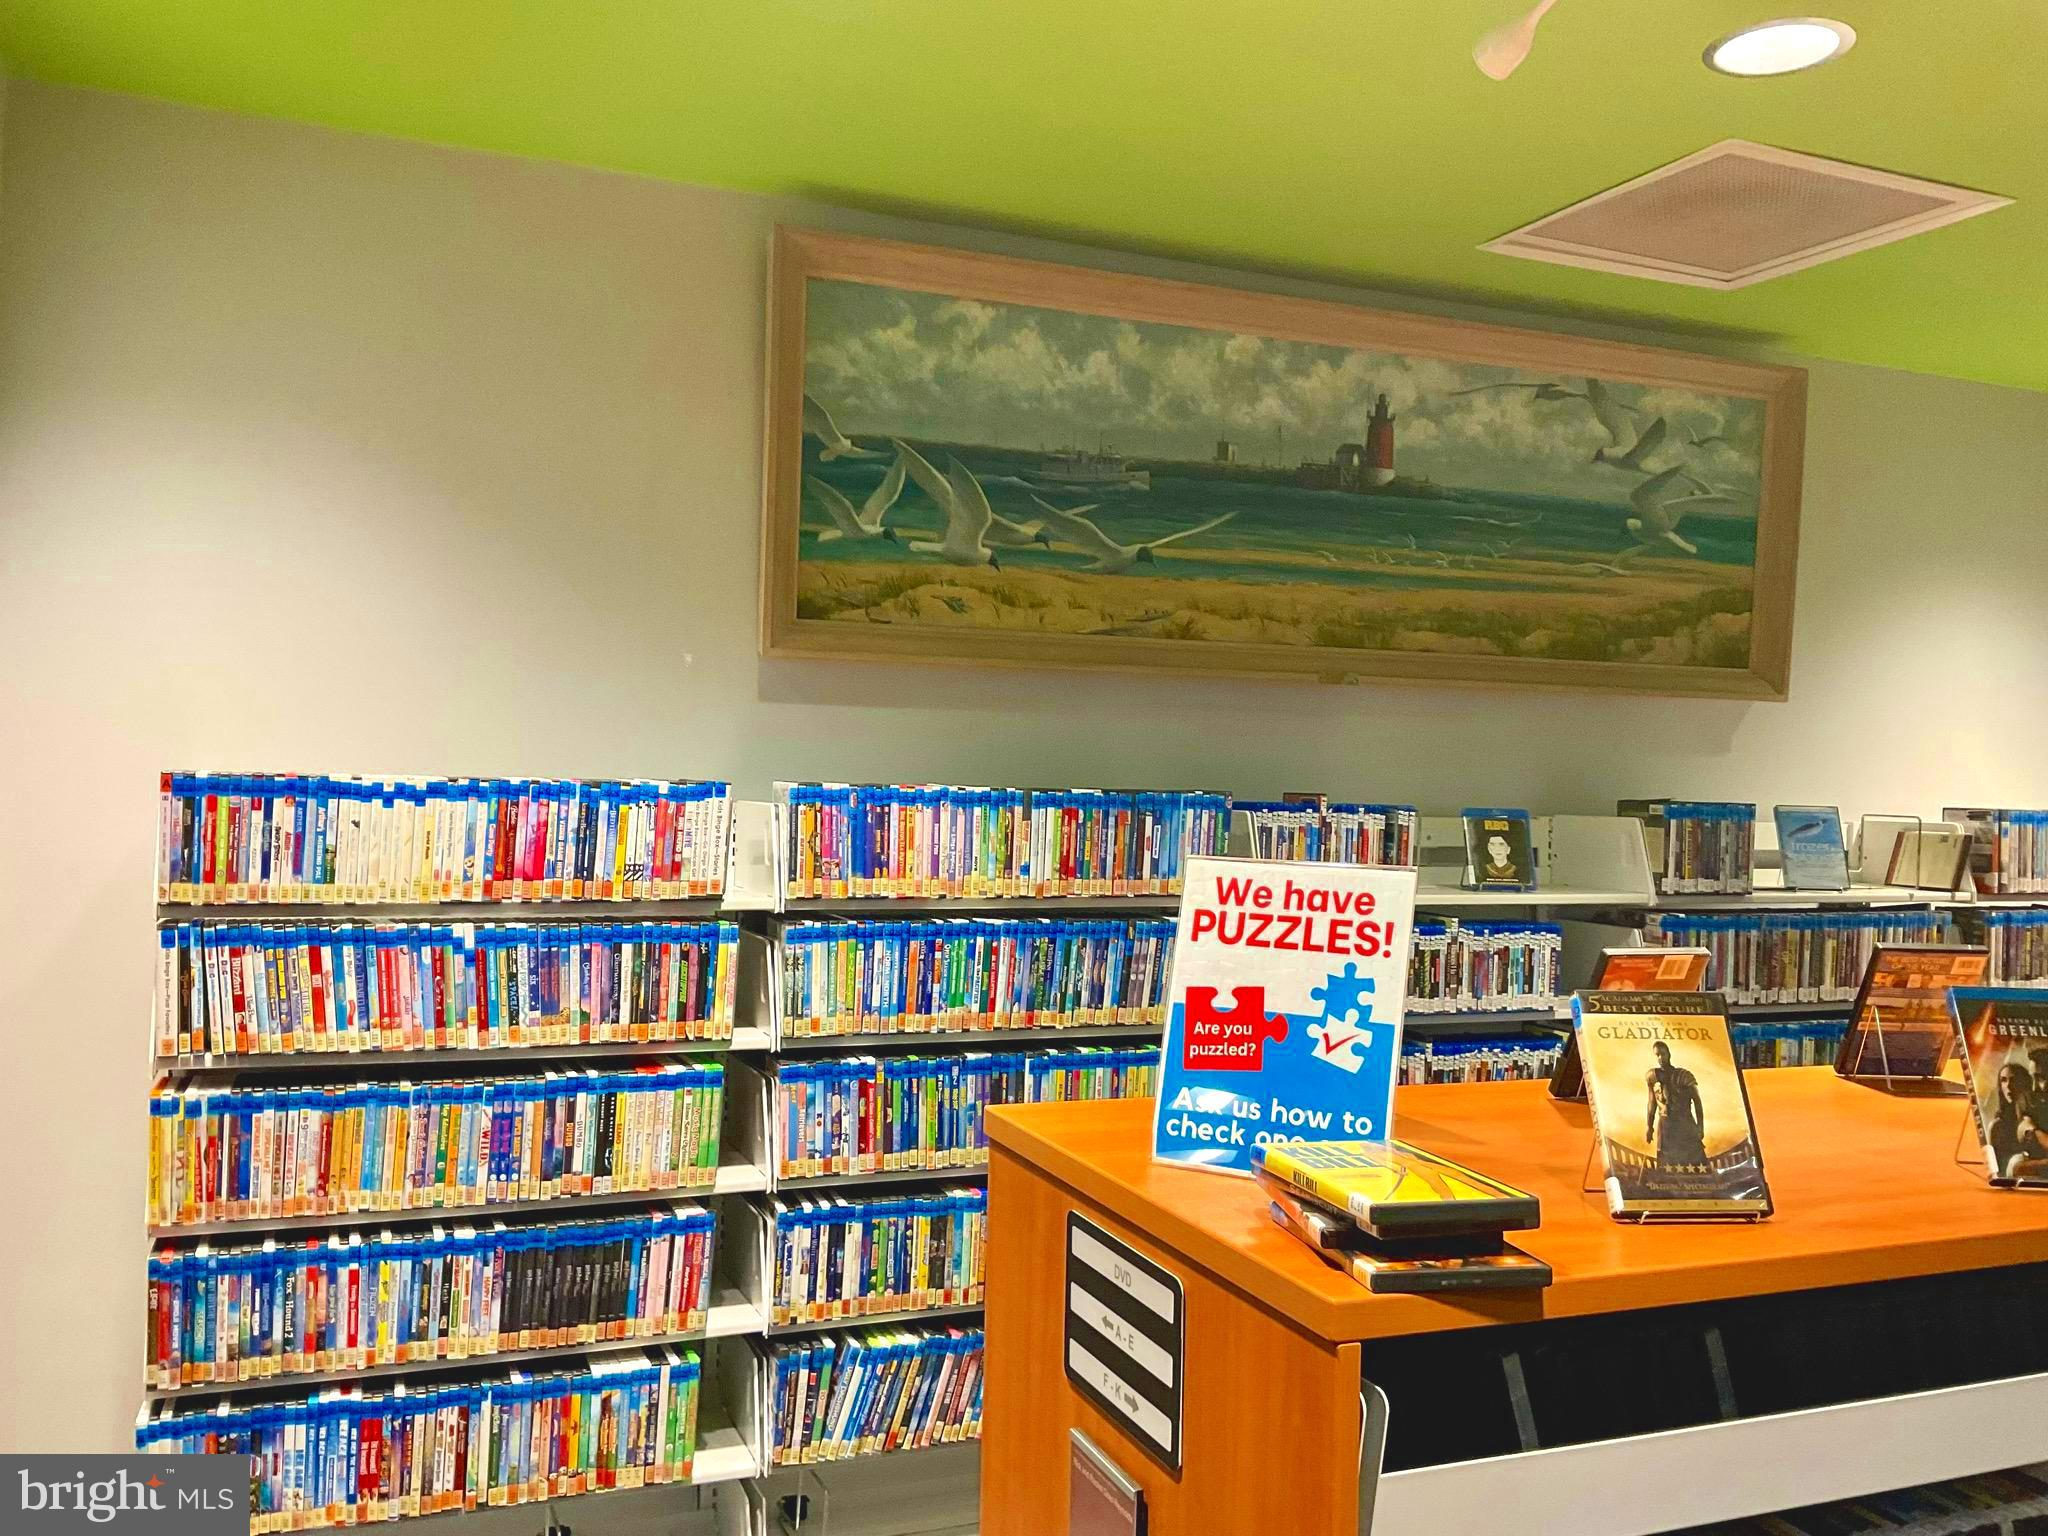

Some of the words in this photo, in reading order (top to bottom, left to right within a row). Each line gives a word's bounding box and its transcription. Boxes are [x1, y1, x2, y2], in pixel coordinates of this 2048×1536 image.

[715, 816, 723, 833] Binge
[1216, 877, 1272, 907] We
[1284, 880, 1375, 915] have
[1190, 909, 1394, 958] PUZZLES!
[231, 957, 242, 995] Blizzard
[1588, 995, 1600, 1012] 5
[1643, 1005, 1703, 1014] PICTURE
[1193, 1021, 1220, 1035] Are
[1224, 1024, 1252, 1038] you
[1597, 1027, 1713, 1041] GLADIATOR
[1988, 1024, 2048, 1037] GREENL
[1189, 1042, 1256, 1057] puzzled?
[1232, 1099, 1261, 1120] us
[1271, 1098, 1333, 1130] how
[1343, 1112, 1373, 1135] to
[1165, 1113, 1246, 1146] check
[1114, 1263, 1132, 1288] DVD
[286, 1277, 295, 1294] Fox
[285, 1301, 293, 1332] Hound
